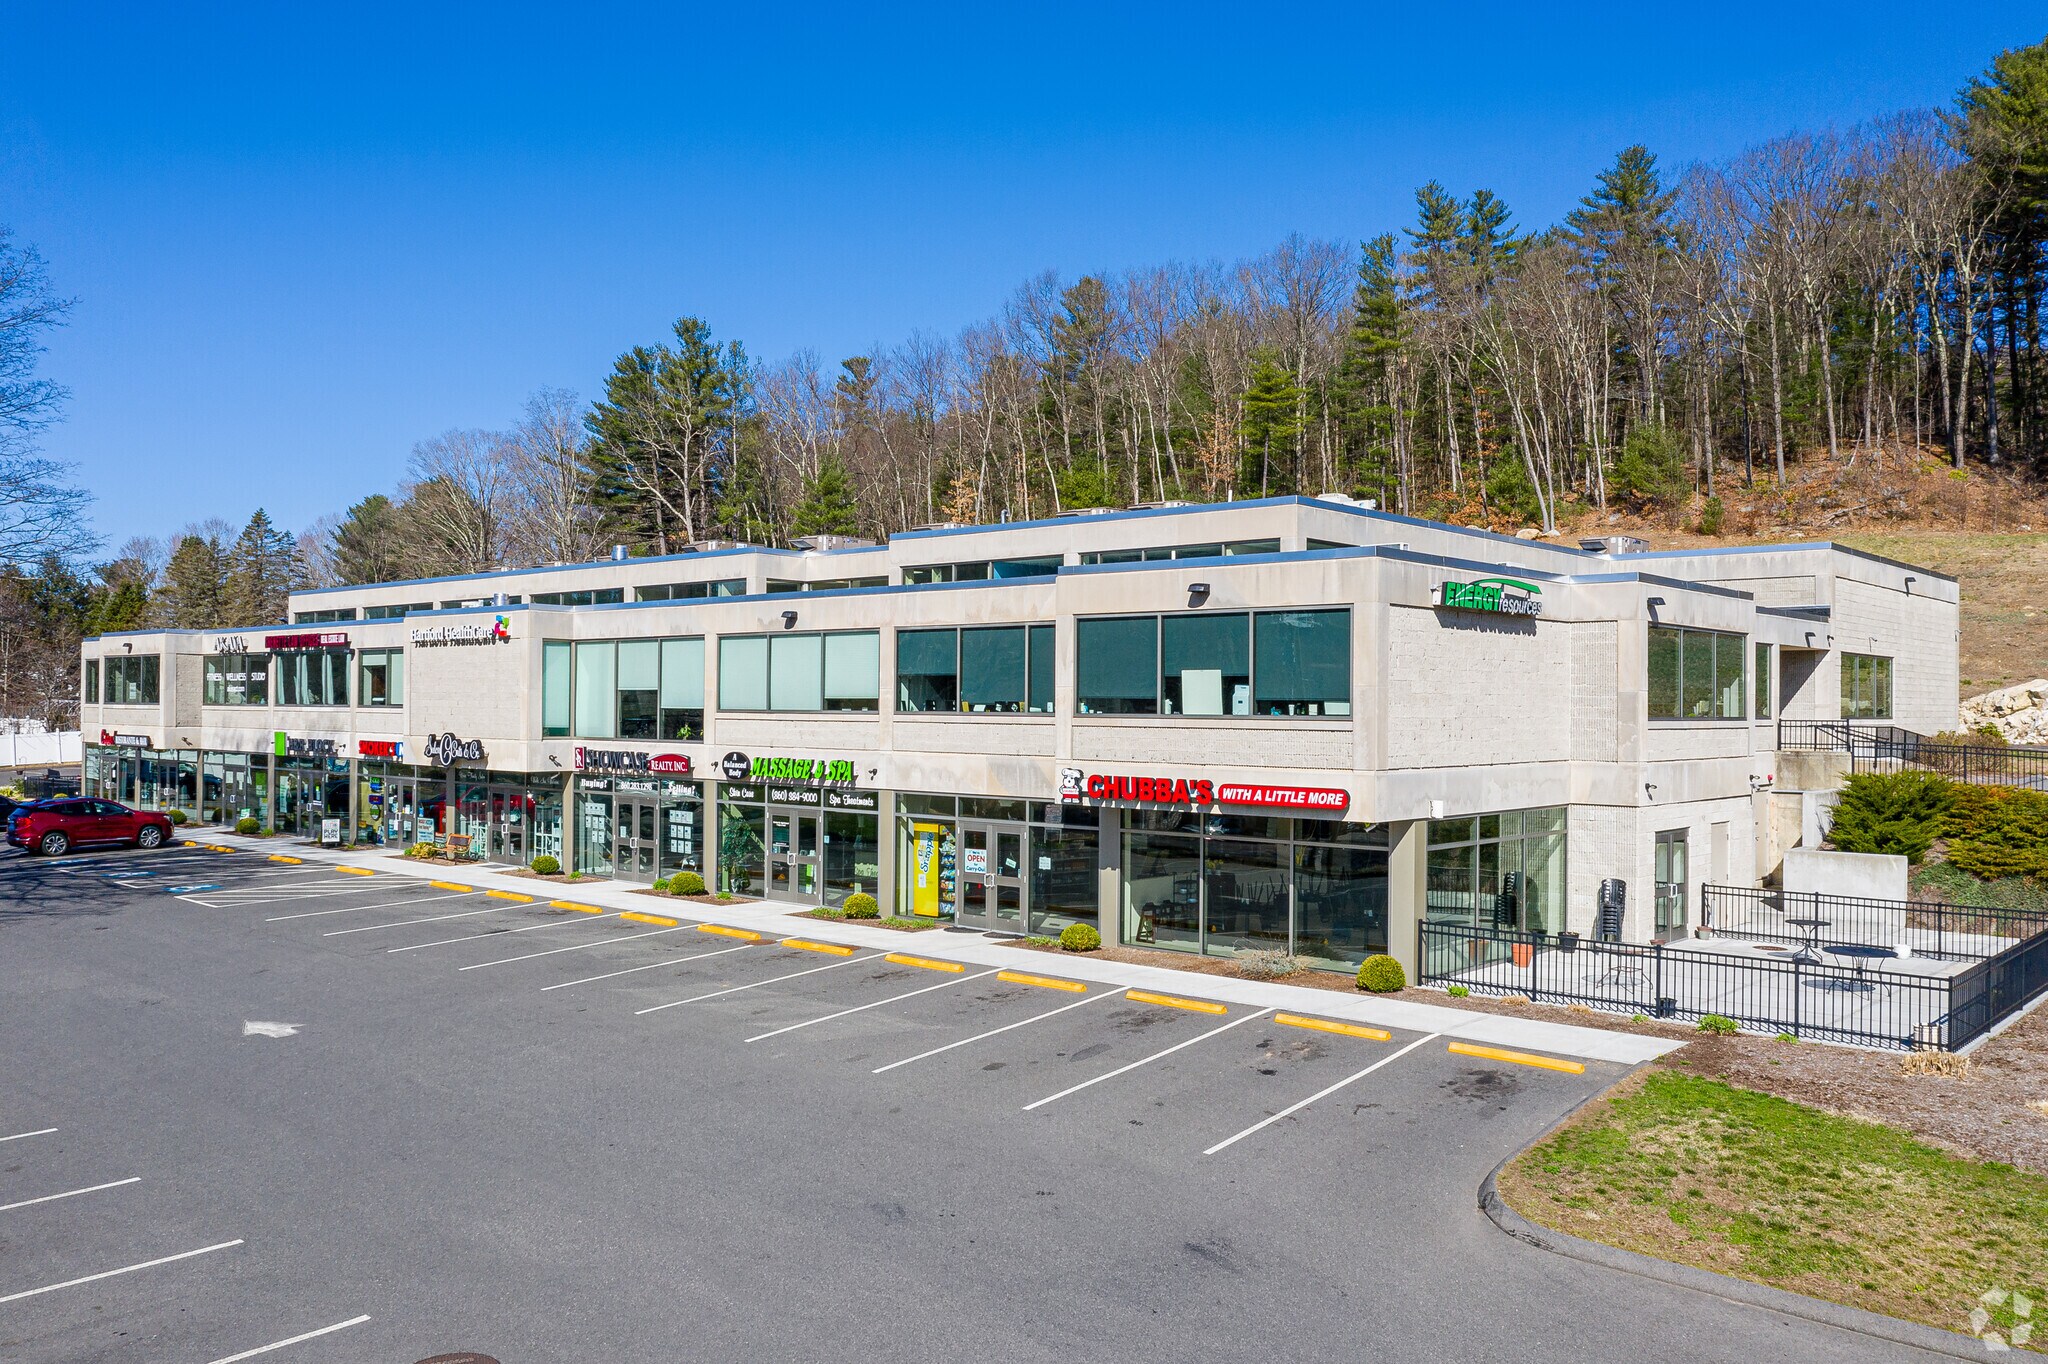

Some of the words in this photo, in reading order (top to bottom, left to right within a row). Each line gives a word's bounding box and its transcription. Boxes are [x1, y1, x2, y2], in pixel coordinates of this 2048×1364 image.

[1446, 581, 1502, 611] ENERGY
[1499, 597, 1542, 615] resources
[411, 627, 446, 640] Hartford
[447, 626, 493, 639] HealthCare
[207, 672, 223, 681] FITNESS
[226, 672, 247, 681] WELLNESS
[251, 672, 266, 681] STUDIO
[308, 739, 336, 753] BLOCK
[359, 740, 396, 756] SMOKER'S
[586, 749, 649, 771] SHOWCASE
[674, 761, 688, 772] INC.
[729, 769, 741, 778] Body
[750, 757, 812, 779] MASSAGE
[813, 760, 824, 778] &
[825, 760, 852, 781] SPA
[581, 779, 607, 788] Buying?
[668, 782, 696, 794] Selling?
[729, 787, 741, 797] Skin
[742, 788, 754, 798] Care
[771, 790, 787, 801] (860)
[1087, 774, 1213, 805] CHUBBA'S
[1222, 788, 1252, 801] WITH
[1253, 790, 1262, 801] A
[1264, 790, 1306, 803] LITTLE
[1307, 792, 1344, 806] MORE
[829, 794, 841, 806] Spa
[843, 795, 874, 806] Treatments
[920, 832, 934, 872] Snapple
[967, 854, 986, 863] OPEN
